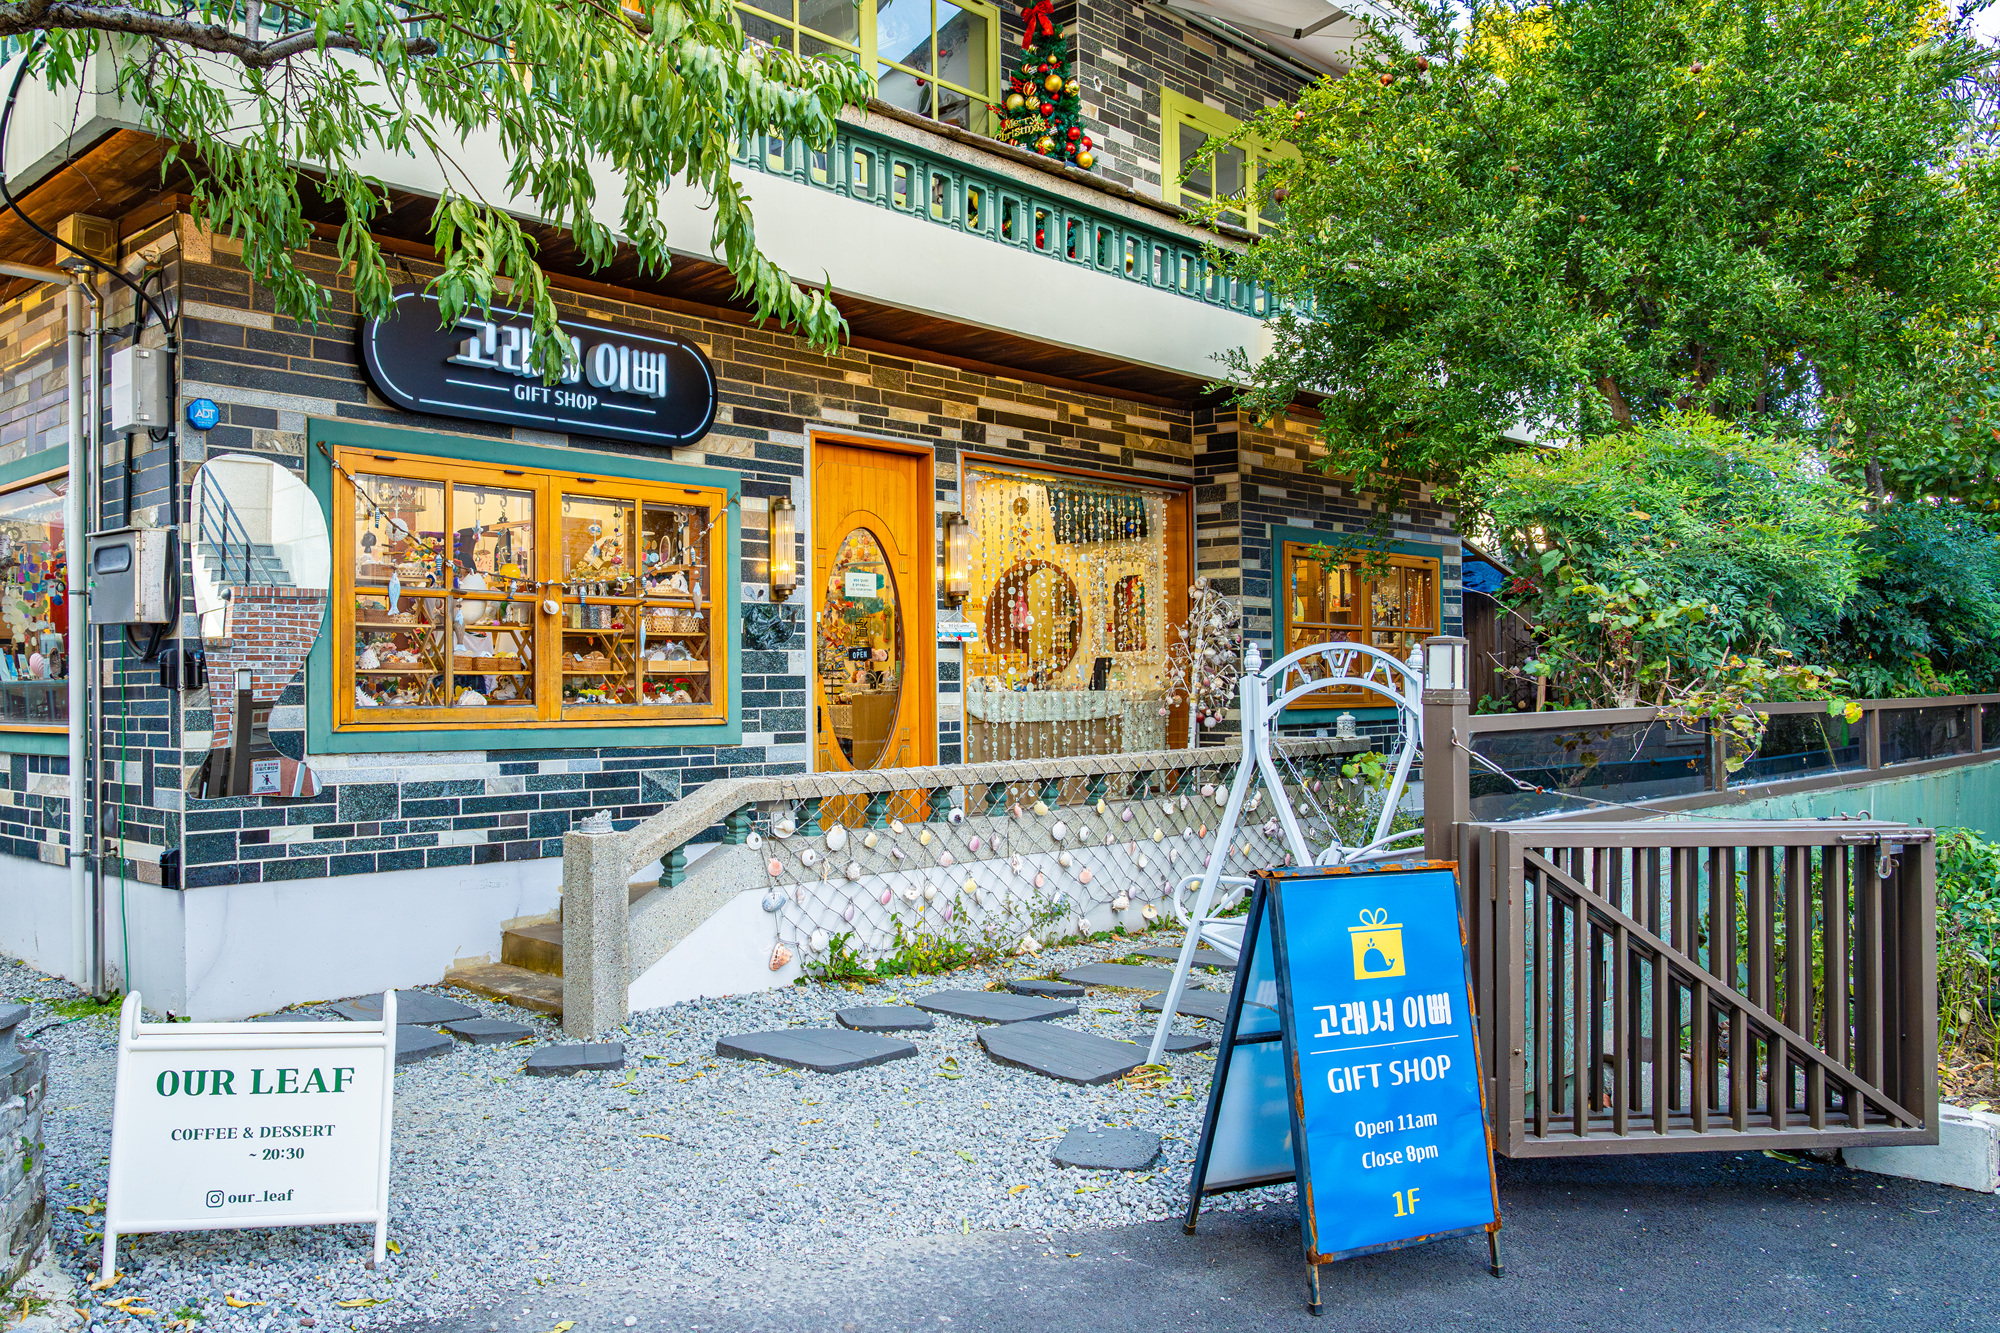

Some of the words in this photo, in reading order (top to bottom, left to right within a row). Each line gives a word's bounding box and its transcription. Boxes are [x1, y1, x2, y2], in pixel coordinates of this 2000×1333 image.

[994, 123, 1046, 142] Christmas
[1005, 116, 1036, 129] Merry
[586, 343, 667, 398] 이뻐
[514, 384, 551, 404] GIFT
[554, 390, 598, 410] SHOP
[194, 408, 215, 419] ADT
[852, 651, 868, 659] OPEN
[1313, 998, 1395, 1038] 고래서
[1402, 992, 1453, 1028] 이뻐
[156, 1069, 237, 1097] OUR
[249, 1067, 355, 1095] LEAF
[1327, 1063, 1382, 1094] GIFT
[1389, 1054, 1451, 1086] SHOP
[171, 1127, 238, 1141] COFFEE
[242, 1127, 254, 1139] &
[259, 1124, 336, 1138] DESSERT
[1355, 1120, 1394, 1139] Open
[1397, 1113, 1438, 1131] 11am
[262, 1147, 305, 1161] 20:30
[1362, 1150, 1403, 1169] Close
[1405, 1145, 1439, 1163] 8pm
[228, 1189, 294, 1203] our_leaf
[1392, 1187, 1420, 1217] 1F
